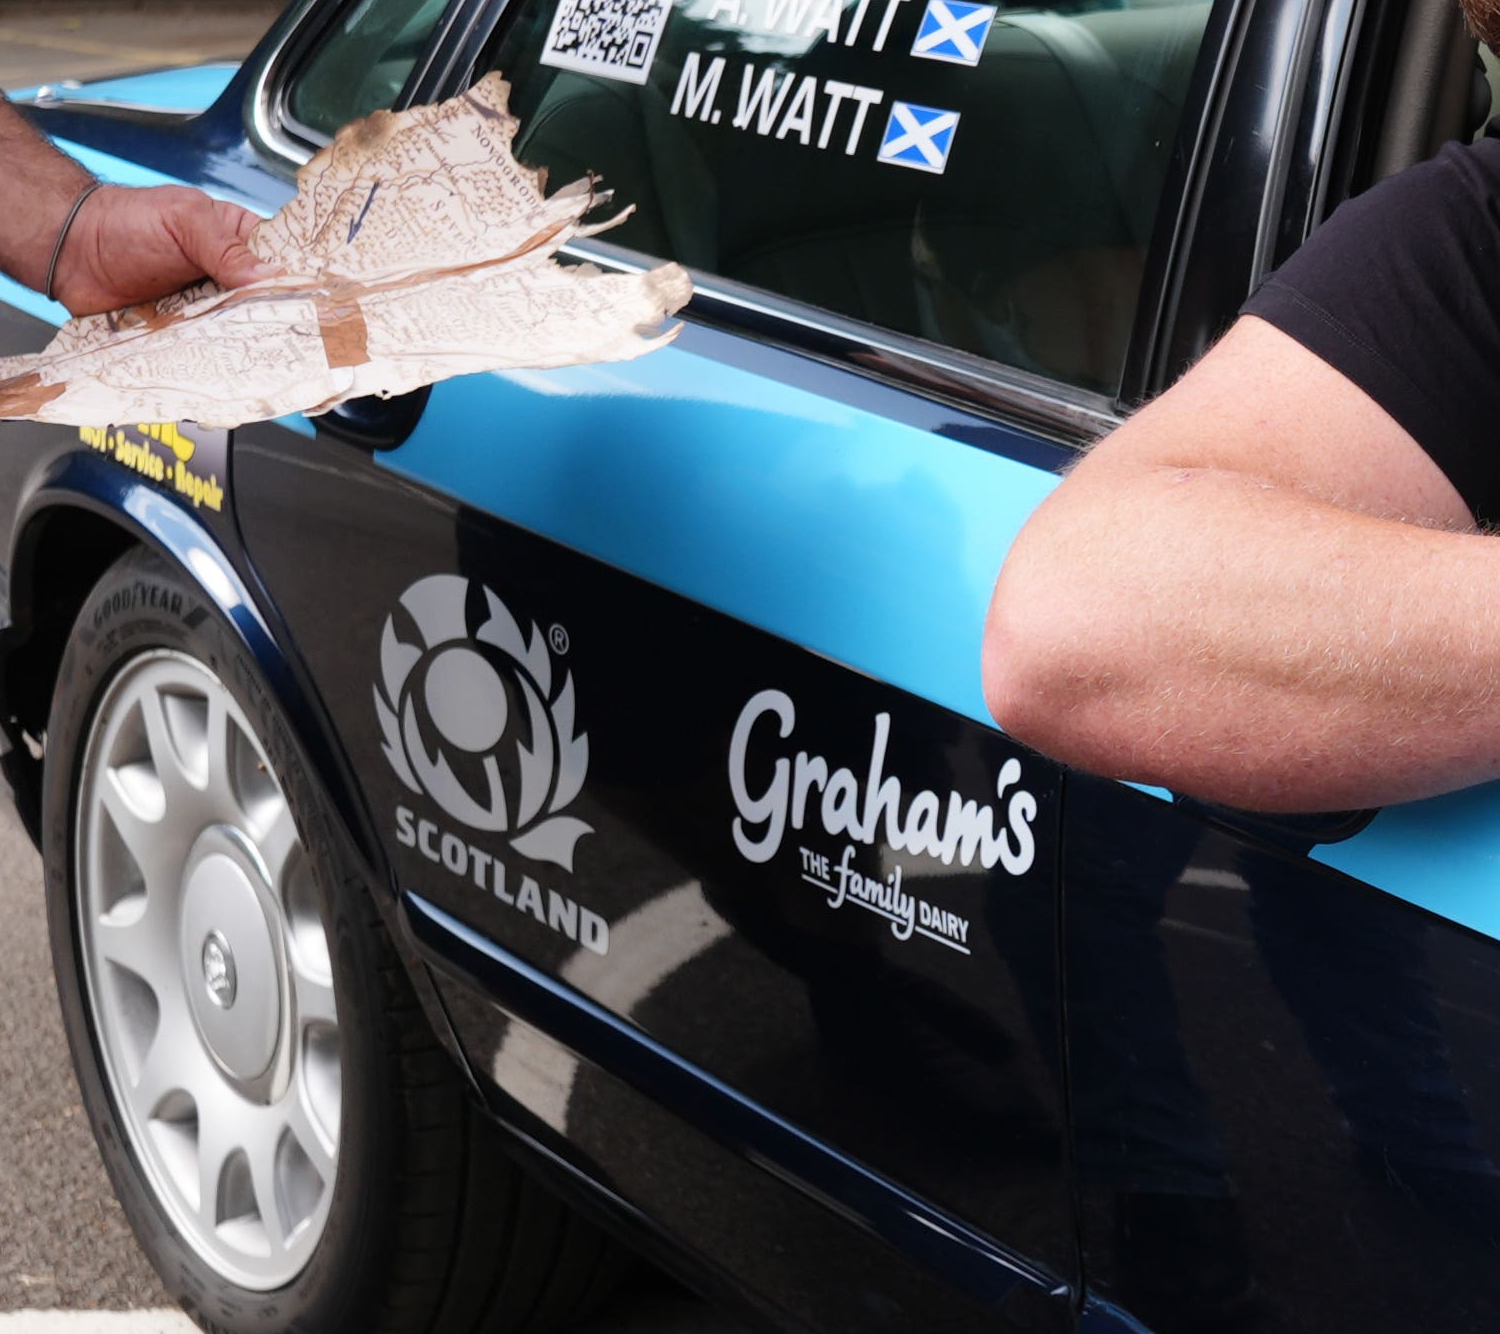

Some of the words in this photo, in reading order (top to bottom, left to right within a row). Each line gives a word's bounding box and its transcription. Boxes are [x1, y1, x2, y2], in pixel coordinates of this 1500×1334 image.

[670, 52, 725, 123] M.
[734, 65, 883, 156] WATT
[115, 429, 164, 482] Service
[175, 458, 223, 512] Repair
[728, 688, 1037, 876] Graham's
[394, 804, 610, 956] SCOTLAND
[799, 846, 831, 881] THE
[827, 845, 916, 941] family
[919, 900, 970, 943] DAIRY
